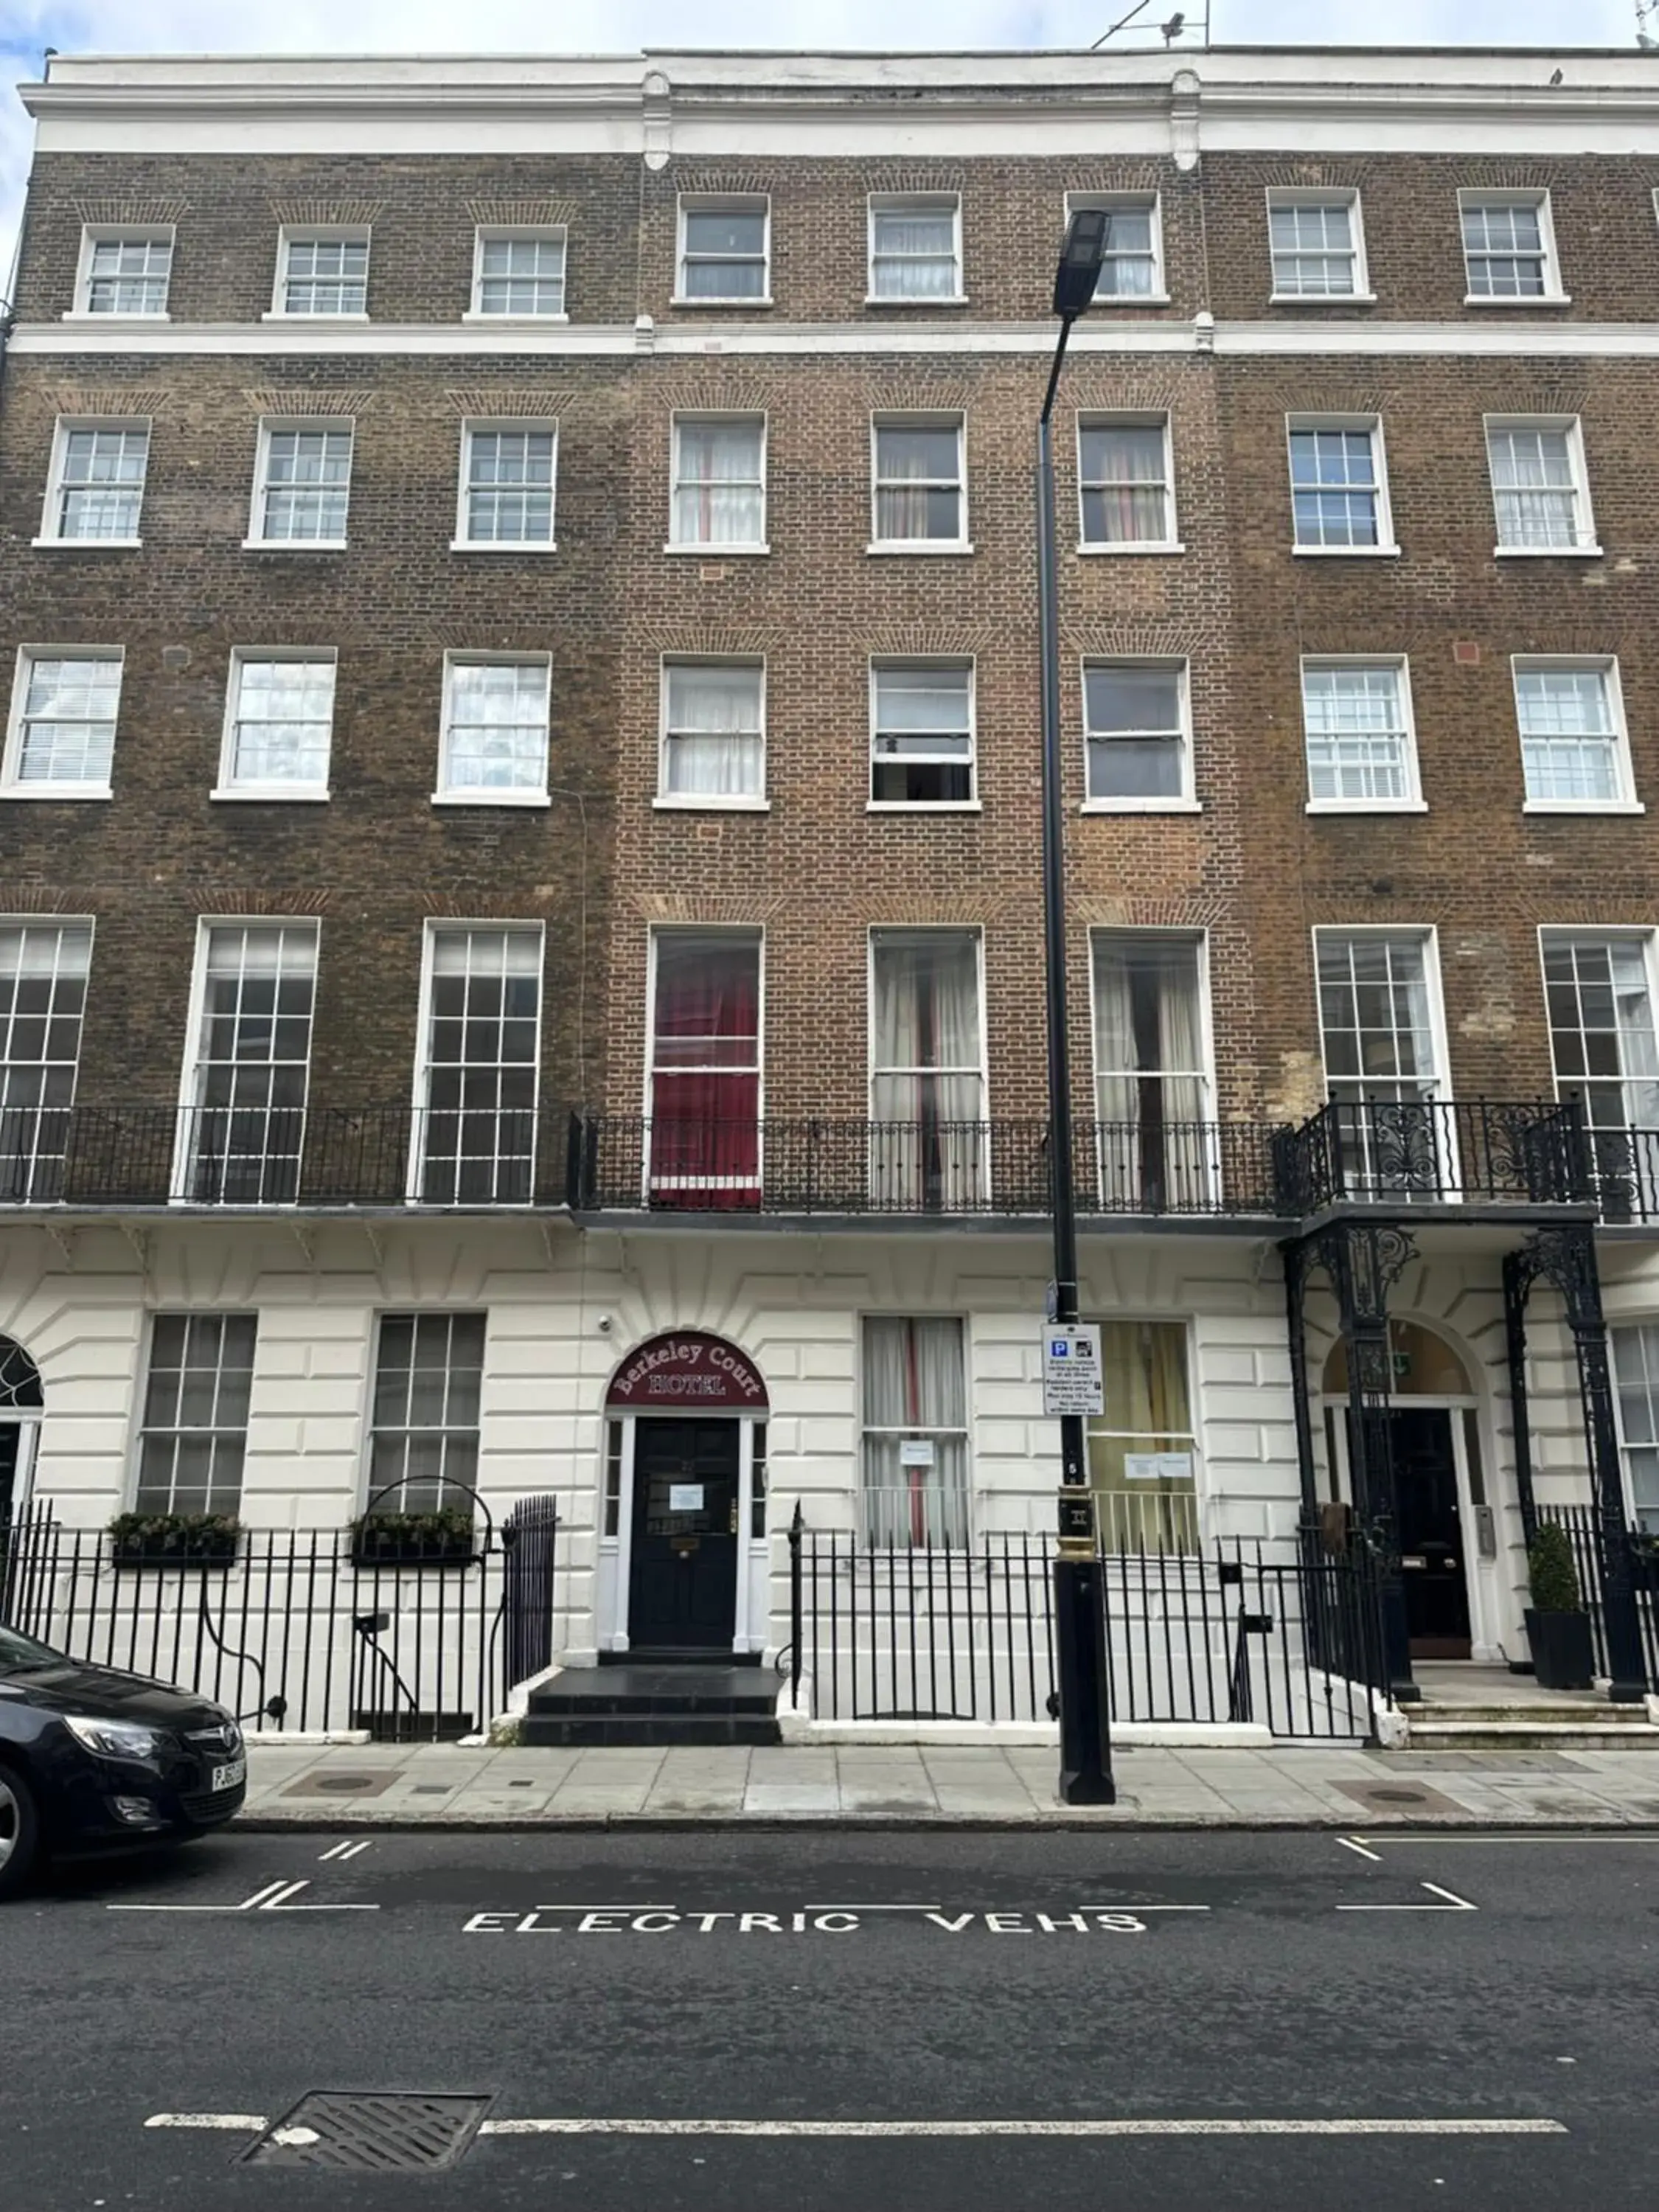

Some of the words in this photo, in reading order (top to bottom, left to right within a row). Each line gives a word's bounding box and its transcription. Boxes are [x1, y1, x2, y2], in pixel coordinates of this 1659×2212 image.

[613, 1341, 703, 1396] Berkeley
[709, 1346, 761, 1397] Court
[648, 1373, 726, 1396] HOTEL
[462, 1912, 860, 1933] ELECTRIC
[925, 1913, 1147, 1933] VEHS
